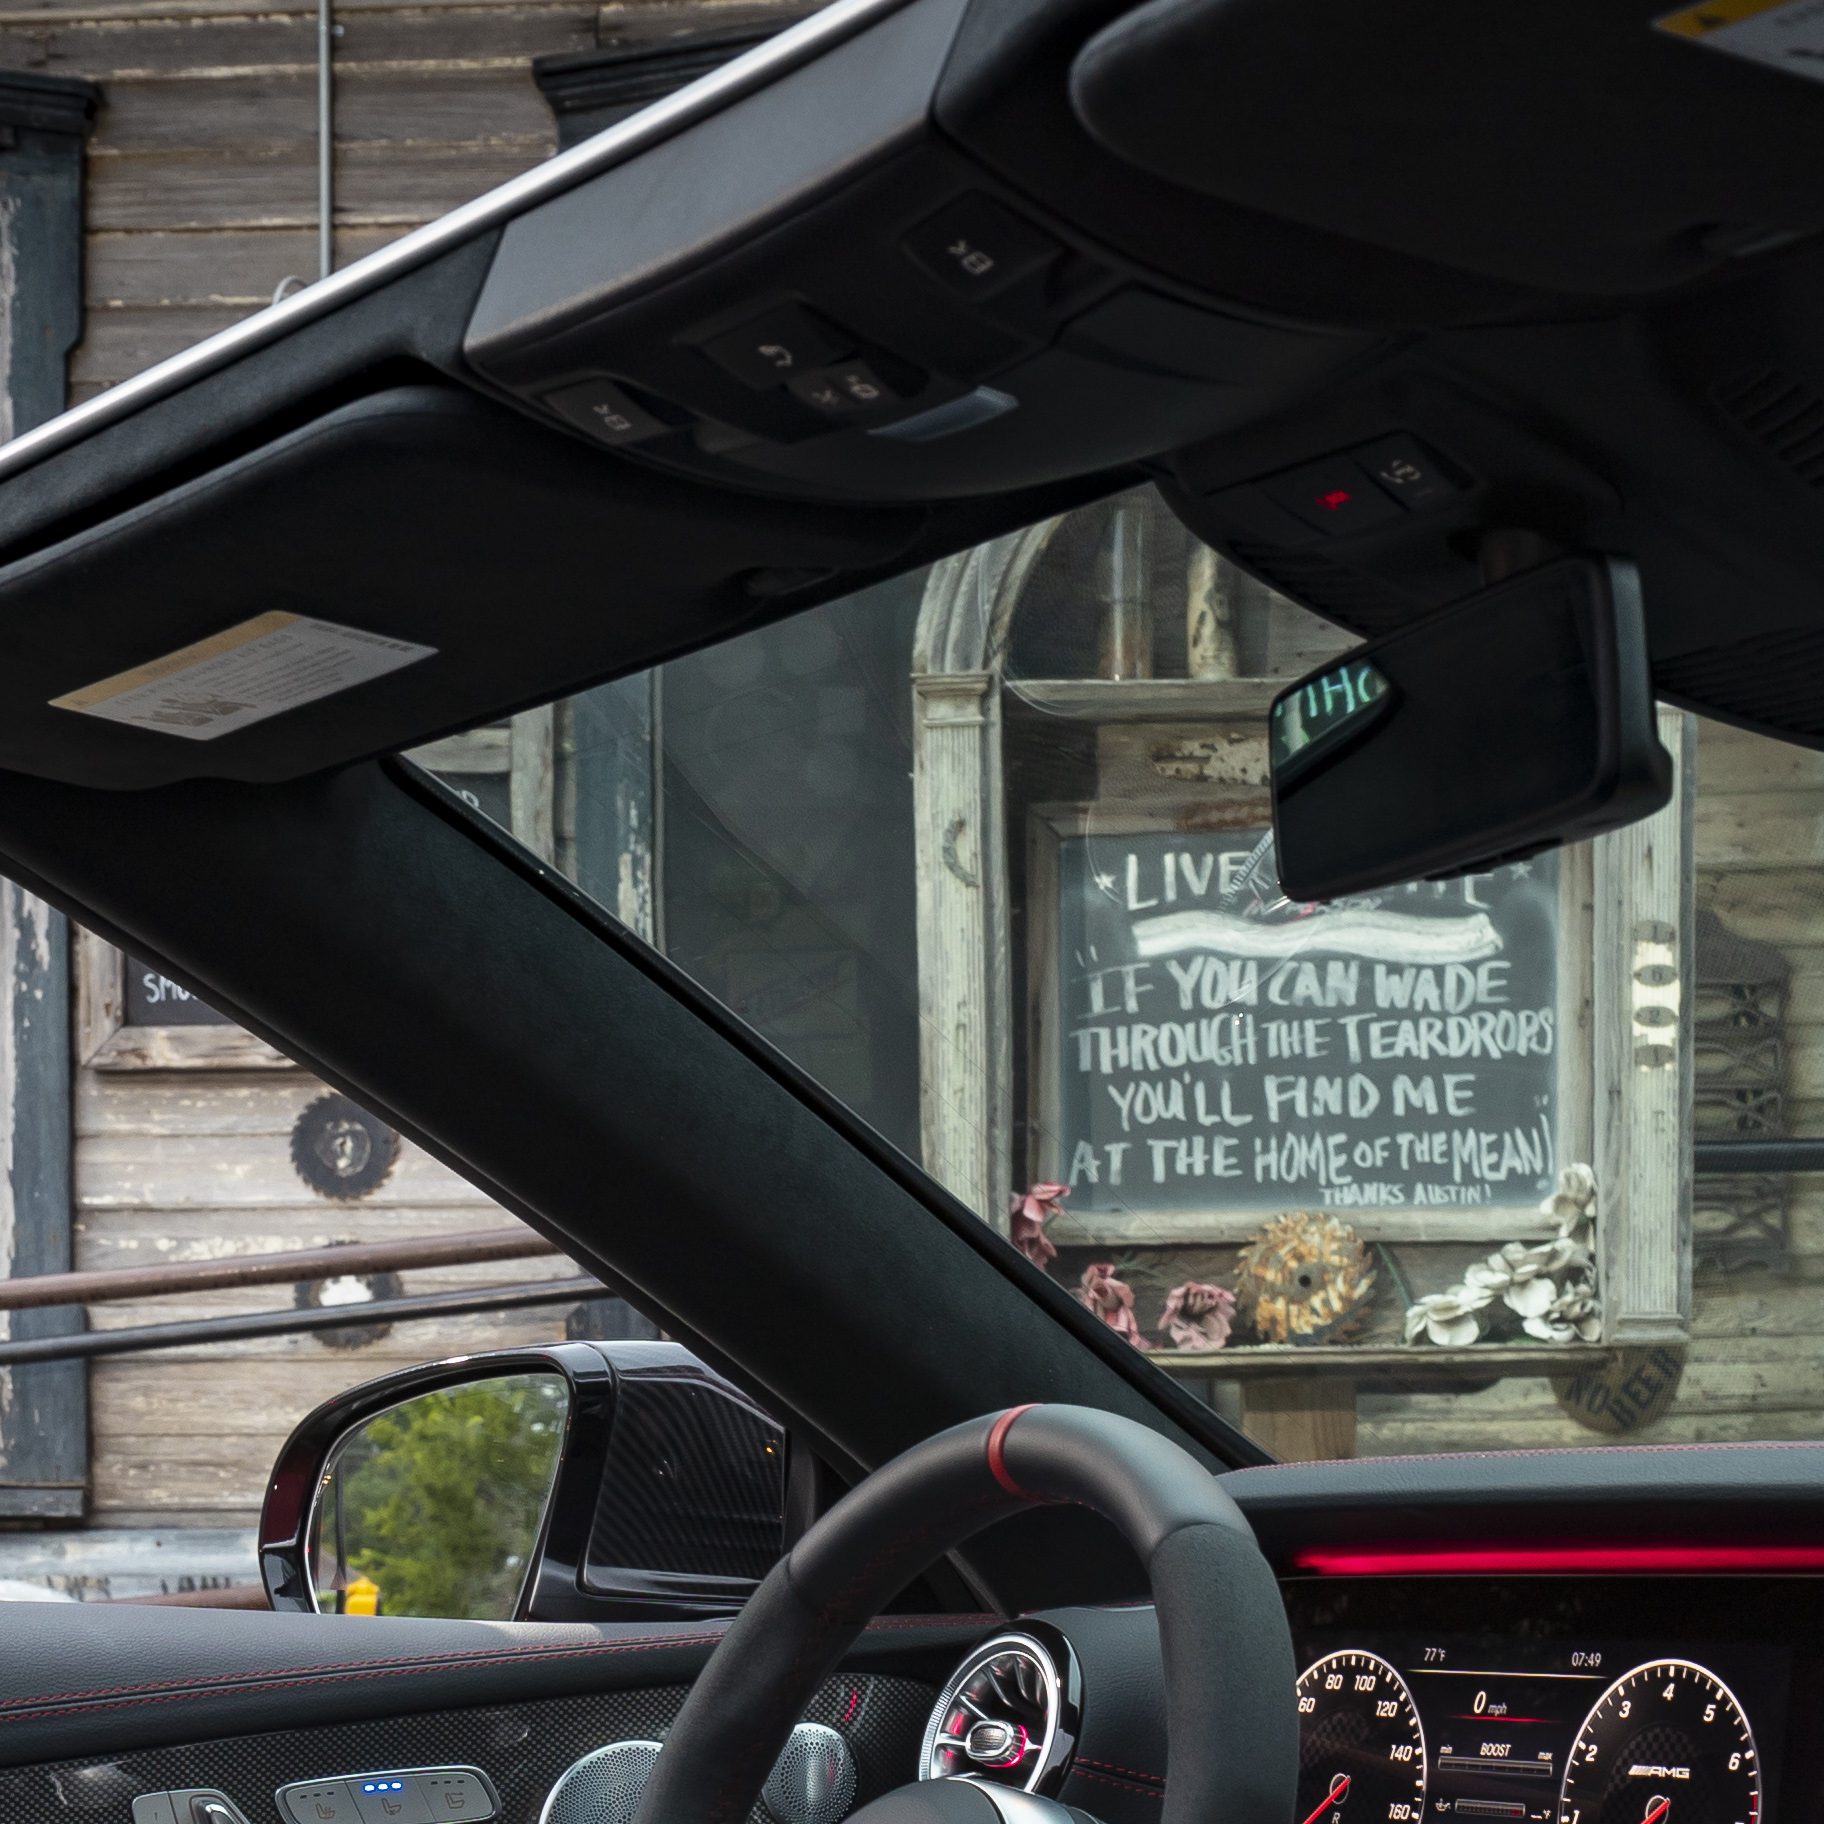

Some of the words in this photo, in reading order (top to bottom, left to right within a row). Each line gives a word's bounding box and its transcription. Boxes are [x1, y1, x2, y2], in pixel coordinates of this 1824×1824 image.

[1126, 850, 1254, 911] LIVE
[142, 973, 198, 1004] SM
[1168, 958, 1257, 1011] YOU
[1268, 962, 1359, 1007] CAN
[1374, 960, 1513, 1014] WADE
[1068, 1015, 1257, 1074] THROUGH
[1260, 1017, 1333, 1059] THE
[1337, 1008, 1555, 1065] TEARDROPS
[1107, 1074, 1253, 1131] YOU'LL
[1264, 1074, 1382, 1123] FIND
[1392, 1073, 1476, 1117] ME
[1066, 1140, 1124, 1187] AT
[1147, 1136, 1243, 1183] THE
[1253, 1131, 1349, 1185] HOME
[1353, 1139, 1394, 1171] OF
[1396, 1129, 1452, 1175] THE
[1320, 1183, 1406, 1207] THANKS
[1571, 1652, 1602, 1667] 07:49
[1325, 1674, 1343, 1690] 80
[1354, 1675, 1376, 1692] 100
[1662, 1683, 1675, 1701] 4
[1298, 1697, 1316, 1713] 60
[1376, 1701, 1398, 1718] 120
[1474, 1691, 1487, 1714] 0
[1487, 1702, 1508, 1716] mph
[1618, 1700, 1631, 1718] 3
[1703, 1704, 1716, 1722] 5
[1389, 1744, 1412, 1762] 140
[1439, 1744, 1453, 1755] min
[1480, 1743, 1512, 1758] BOOST
[1585, 1744, 1598, 1762] 2
[1728, 1752, 1741, 1770] 6
[1648, 1765, 1690, 1779] AMG
[1332, 1812, 1341, 1824] R
[1389, 1803, 1411, 1820] 160
